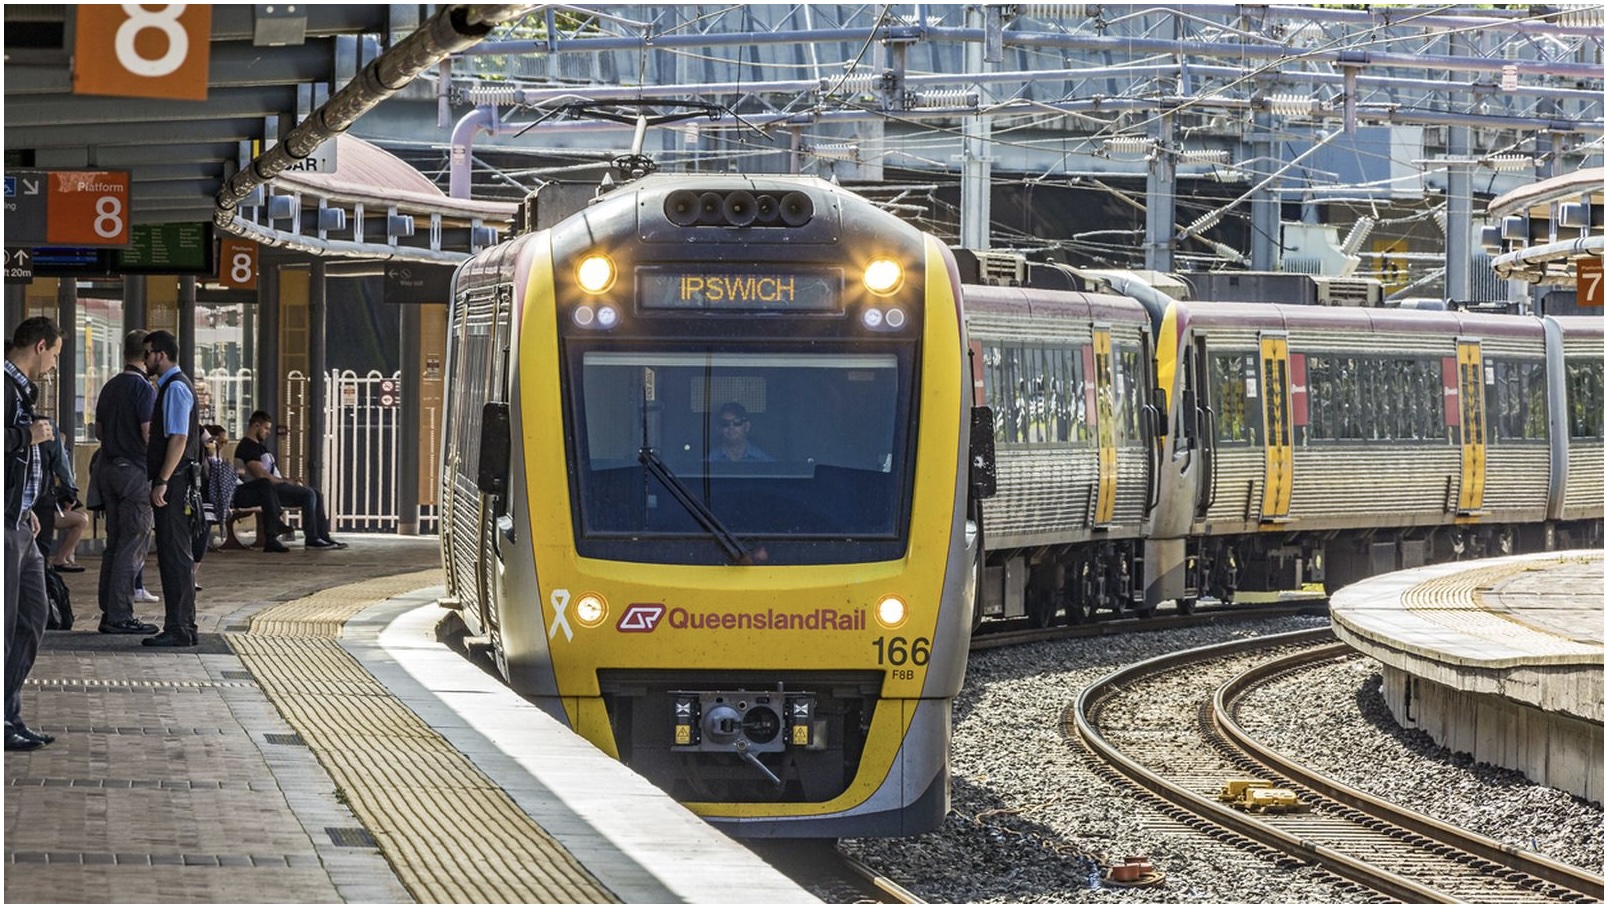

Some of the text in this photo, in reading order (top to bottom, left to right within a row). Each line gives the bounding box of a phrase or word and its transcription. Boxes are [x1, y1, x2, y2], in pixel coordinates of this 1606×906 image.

[114, 4, 189, 77] 8
[284, 158, 317, 171] AR
[77, 181, 124, 193] Platform
[94, 196, 123, 239] 8
[11, 267, 32, 277] 20m
[231, 253, 252, 283] 8
[680, 275, 795, 301] IPSWICH
[1582, 272, 1602, 301] 7
[668, 607, 866, 631] QueenslandRail
[872, 636, 930, 667] 166
[892, 669, 914, 681] F8B
